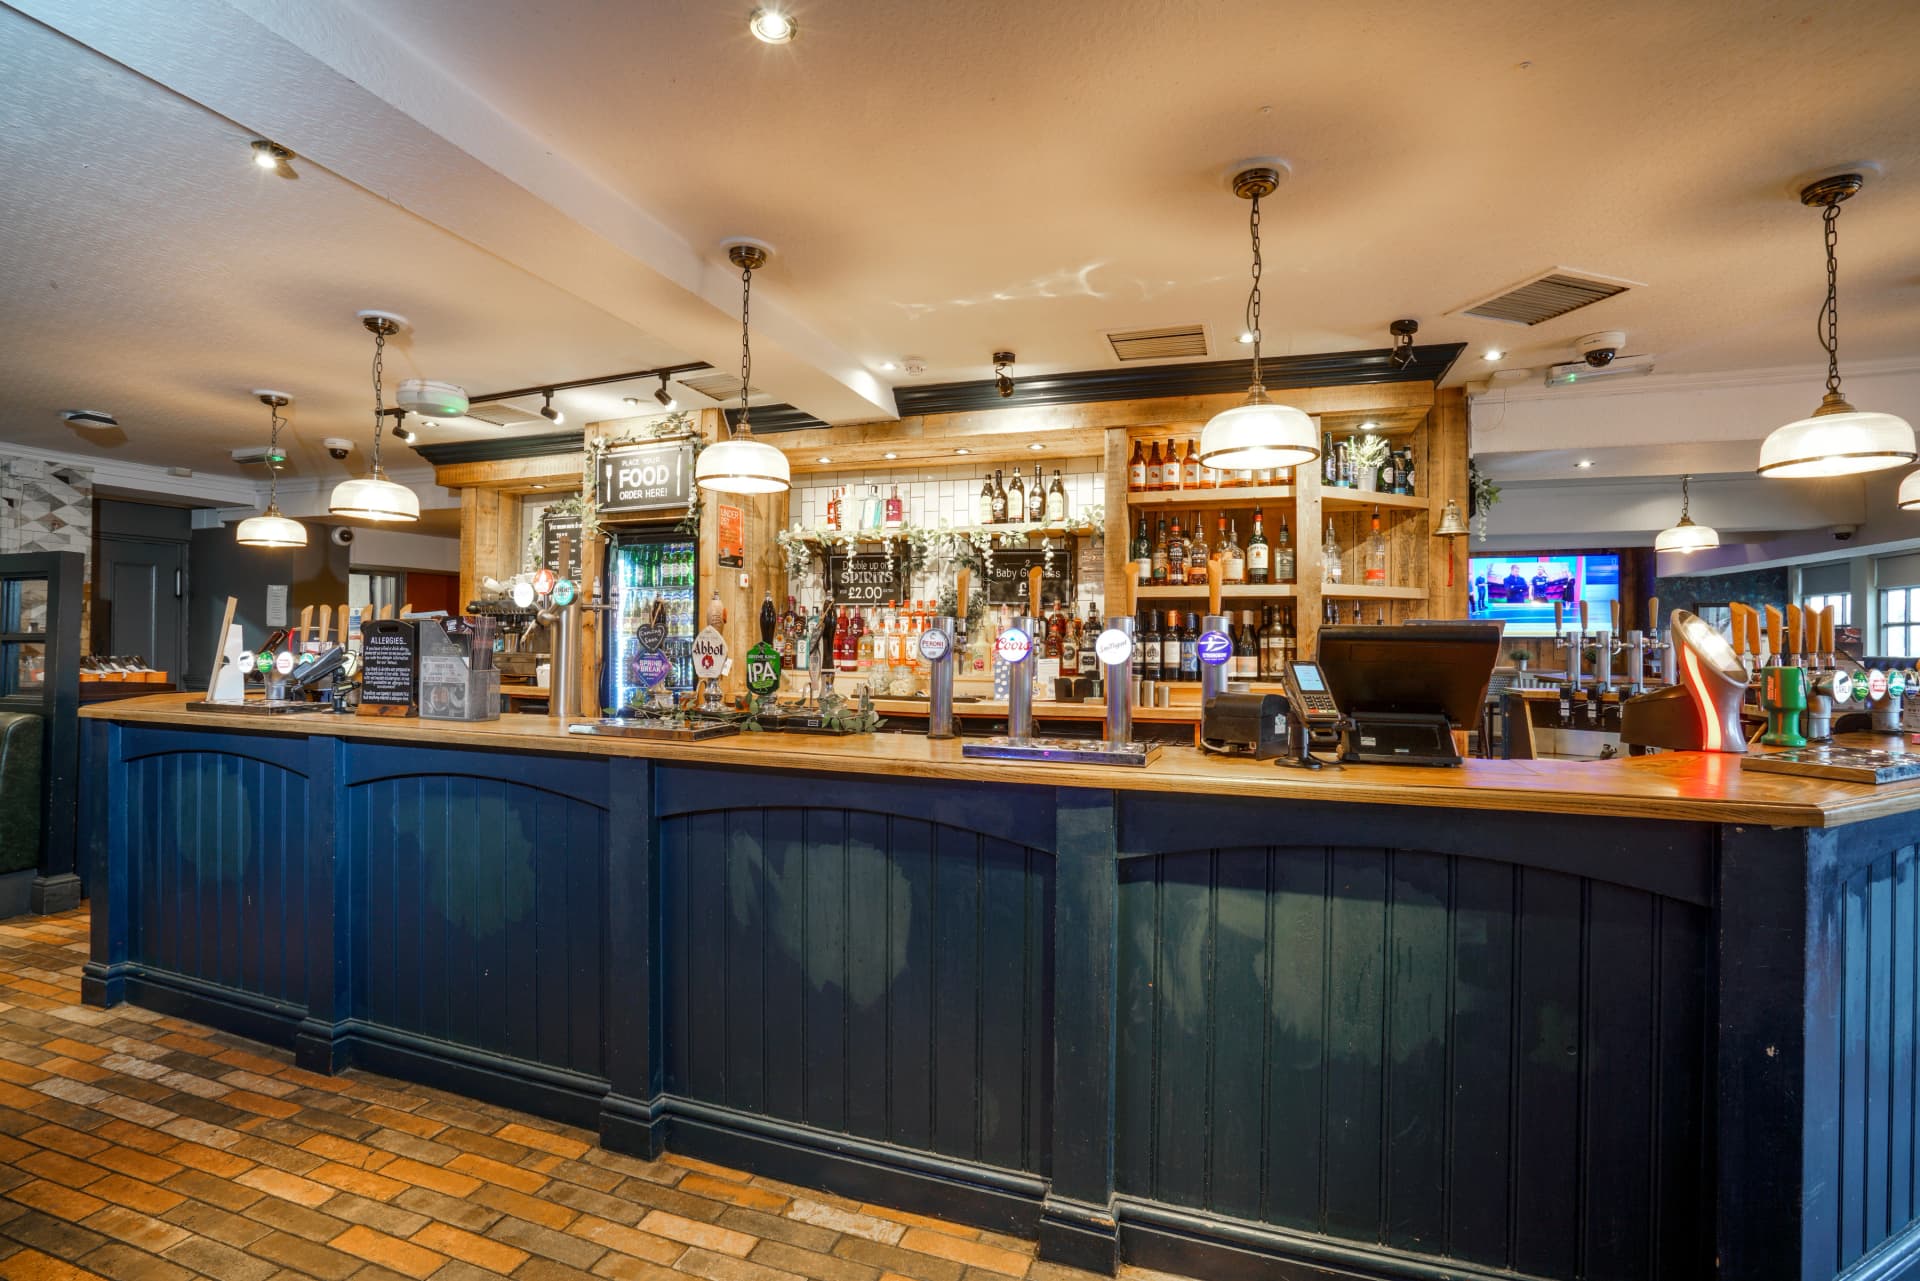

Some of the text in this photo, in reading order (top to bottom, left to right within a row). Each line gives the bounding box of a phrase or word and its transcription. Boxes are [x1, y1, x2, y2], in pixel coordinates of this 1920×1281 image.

[619, 465, 670, 489] FOOD
[619, 487, 668, 501] ORDER HERE!
[842, 560, 868, 571] Duble
[869, 562, 879, 572] up
[1024, 559, 1032, 567] 2
[840, 571, 894, 584] SPIRITS
[996, 567, 1061, 580] Baby Gess
[848, 586, 883, 599] £2.00
[693, 640, 723, 656] Abbot
[995, 637, 1032, 651] Coors
[747, 661, 778, 683] IPA
